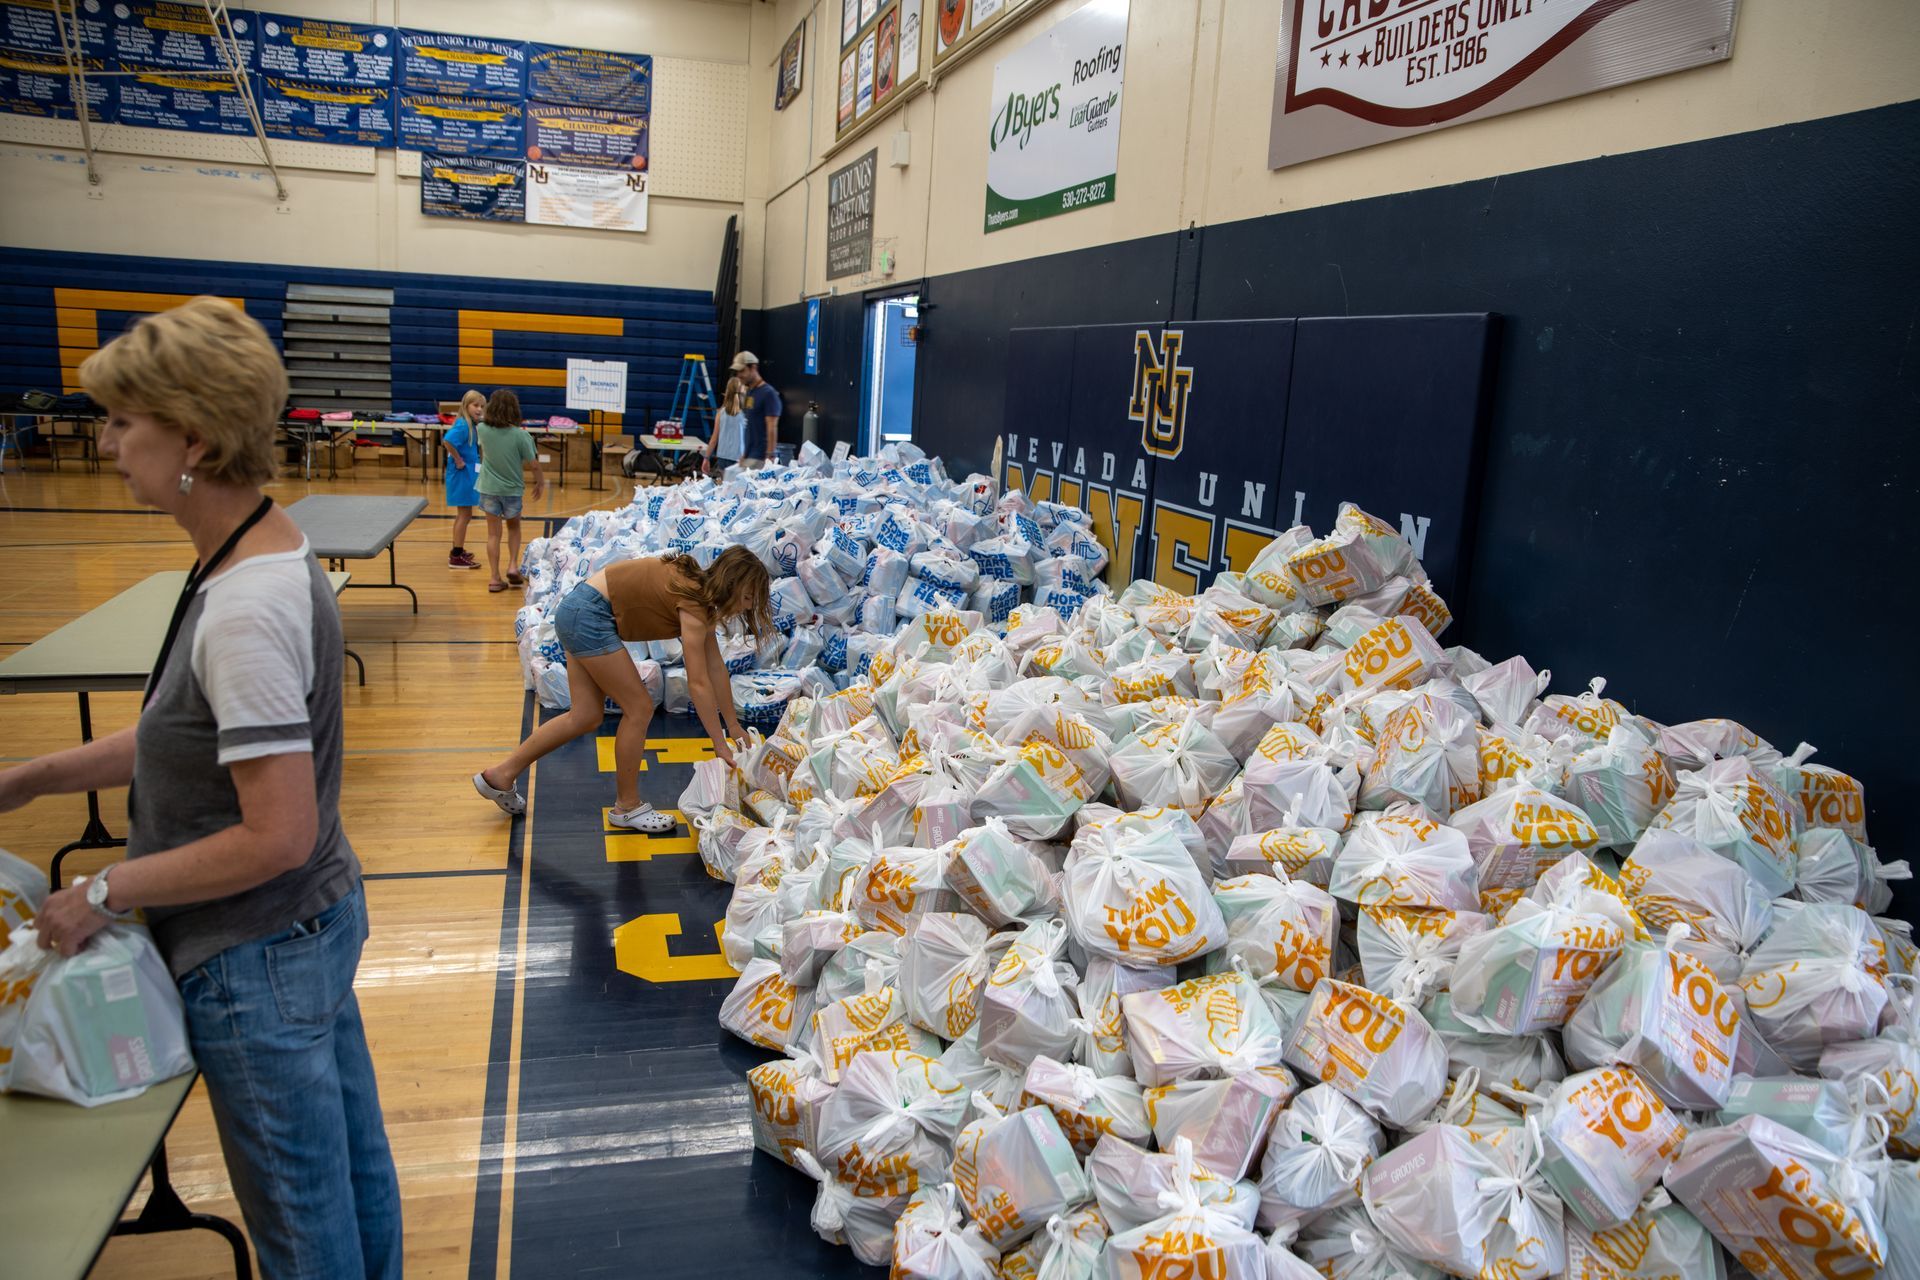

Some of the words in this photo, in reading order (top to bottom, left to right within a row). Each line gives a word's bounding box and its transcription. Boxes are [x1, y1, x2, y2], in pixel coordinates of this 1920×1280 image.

[281, 26, 299, 34] LADY
[329, 31, 370, 42] VOLLEYBALL
[401, 35, 435, 48] NEVADA
[436, 35, 464, 46] UNION
[466, 37, 490, 50] LADY
[491, 42, 524, 62] MINERS
[1373, 2, 1470, 67] BUILDERS
[446, 53, 484, 62] CHAMPIONS
[530, 51, 557, 64] NEVADA
[557, 49, 580, 57] UNION
[581, 50, 608, 59] MINERS
[1072, 44, 1122, 86] Roofing
[266, 77, 332, 92] NEVADA
[336, 86, 389, 100] UNION
[401, 95, 434, 107] NEVADA
[435, 95, 463, 105] UNION
[465, 97, 488, 109] LADY
[489, 101, 522, 118] MINERS
[441, 110, 479, 119] CHAMPIONS
[528, 107, 561, 118] NEVADA
[563, 107, 591, 116] UNION
[593, 109, 615, 119] LADY
[617, 114, 648, 129] MINERS
[1012, 83, 1061, 151] Byers
[562, 123, 615, 133] CHAMPIONS
[1087, 117, 1109, 133] Gutters
[460, 158, 473, 166] BOYS
[473, 158, 493, 168] VARSITY
[494, 161, 525, 177] VOLLEYBALL
[529, 164, 548, 184] NU
[838, 158, 872, 201] YOUNGS
[626, 174, 645, 193] NU
[1062, 182, 1106, 209] 530-272-8272
[830, 198, 856, 229] CARPET
[854, 191, 870, 217] ONE
[988, 208, 1018, 226] ThatsByers.com
[830, 227, 847, 242] FLOOR
[854, 218, 869, 234] HOME
[1129, 329, 1195, 461] NU
[1008, 432, 1148, 490] NEVADA
[1199, 471, 1431, 561] UNIN
[667, 542, 697, 554] HOP
[1291, 550, 1346, 584] YOU
[1252, 571, 1297, 601] HOPE
[1411, 584, 1451, 624] THANK
[1344, 614, 1403, 668] THANK
[1344, 627, 1413, 688] YOU
[761, 753, 797, 783] HO
[767, 750, 799, 770] CONVO
[1800, 771, 1859, 793] THANK
[1799, 791, 1863, 824] YOU
[1511, 822, 1600, 849] YOU
[1103, 878, 1176, 926] THANK
[1103, 896, 1197, 951] YOU
[1273, 941, 1325, 993] YO
[762, 973, 797, 1000] THAN
[1668, 950, 1740, 1038] YOU
[887, 1023, 905, 1038] OF
[1321, 980, 1404, 1054] YOU
[833, 1036, 912, 1070] HOPE
[1018, 1090, 1118, 1139] ANK
[1391, 1153, 1426, 1184] GROOVES
[974, 1203, 1026, 1244] PE
[1753, 1165, 1877, 1280] YOU
[1783, 1158, 1886, 1270] THANK
[1131, 1247, 1227, 1280] YOU
